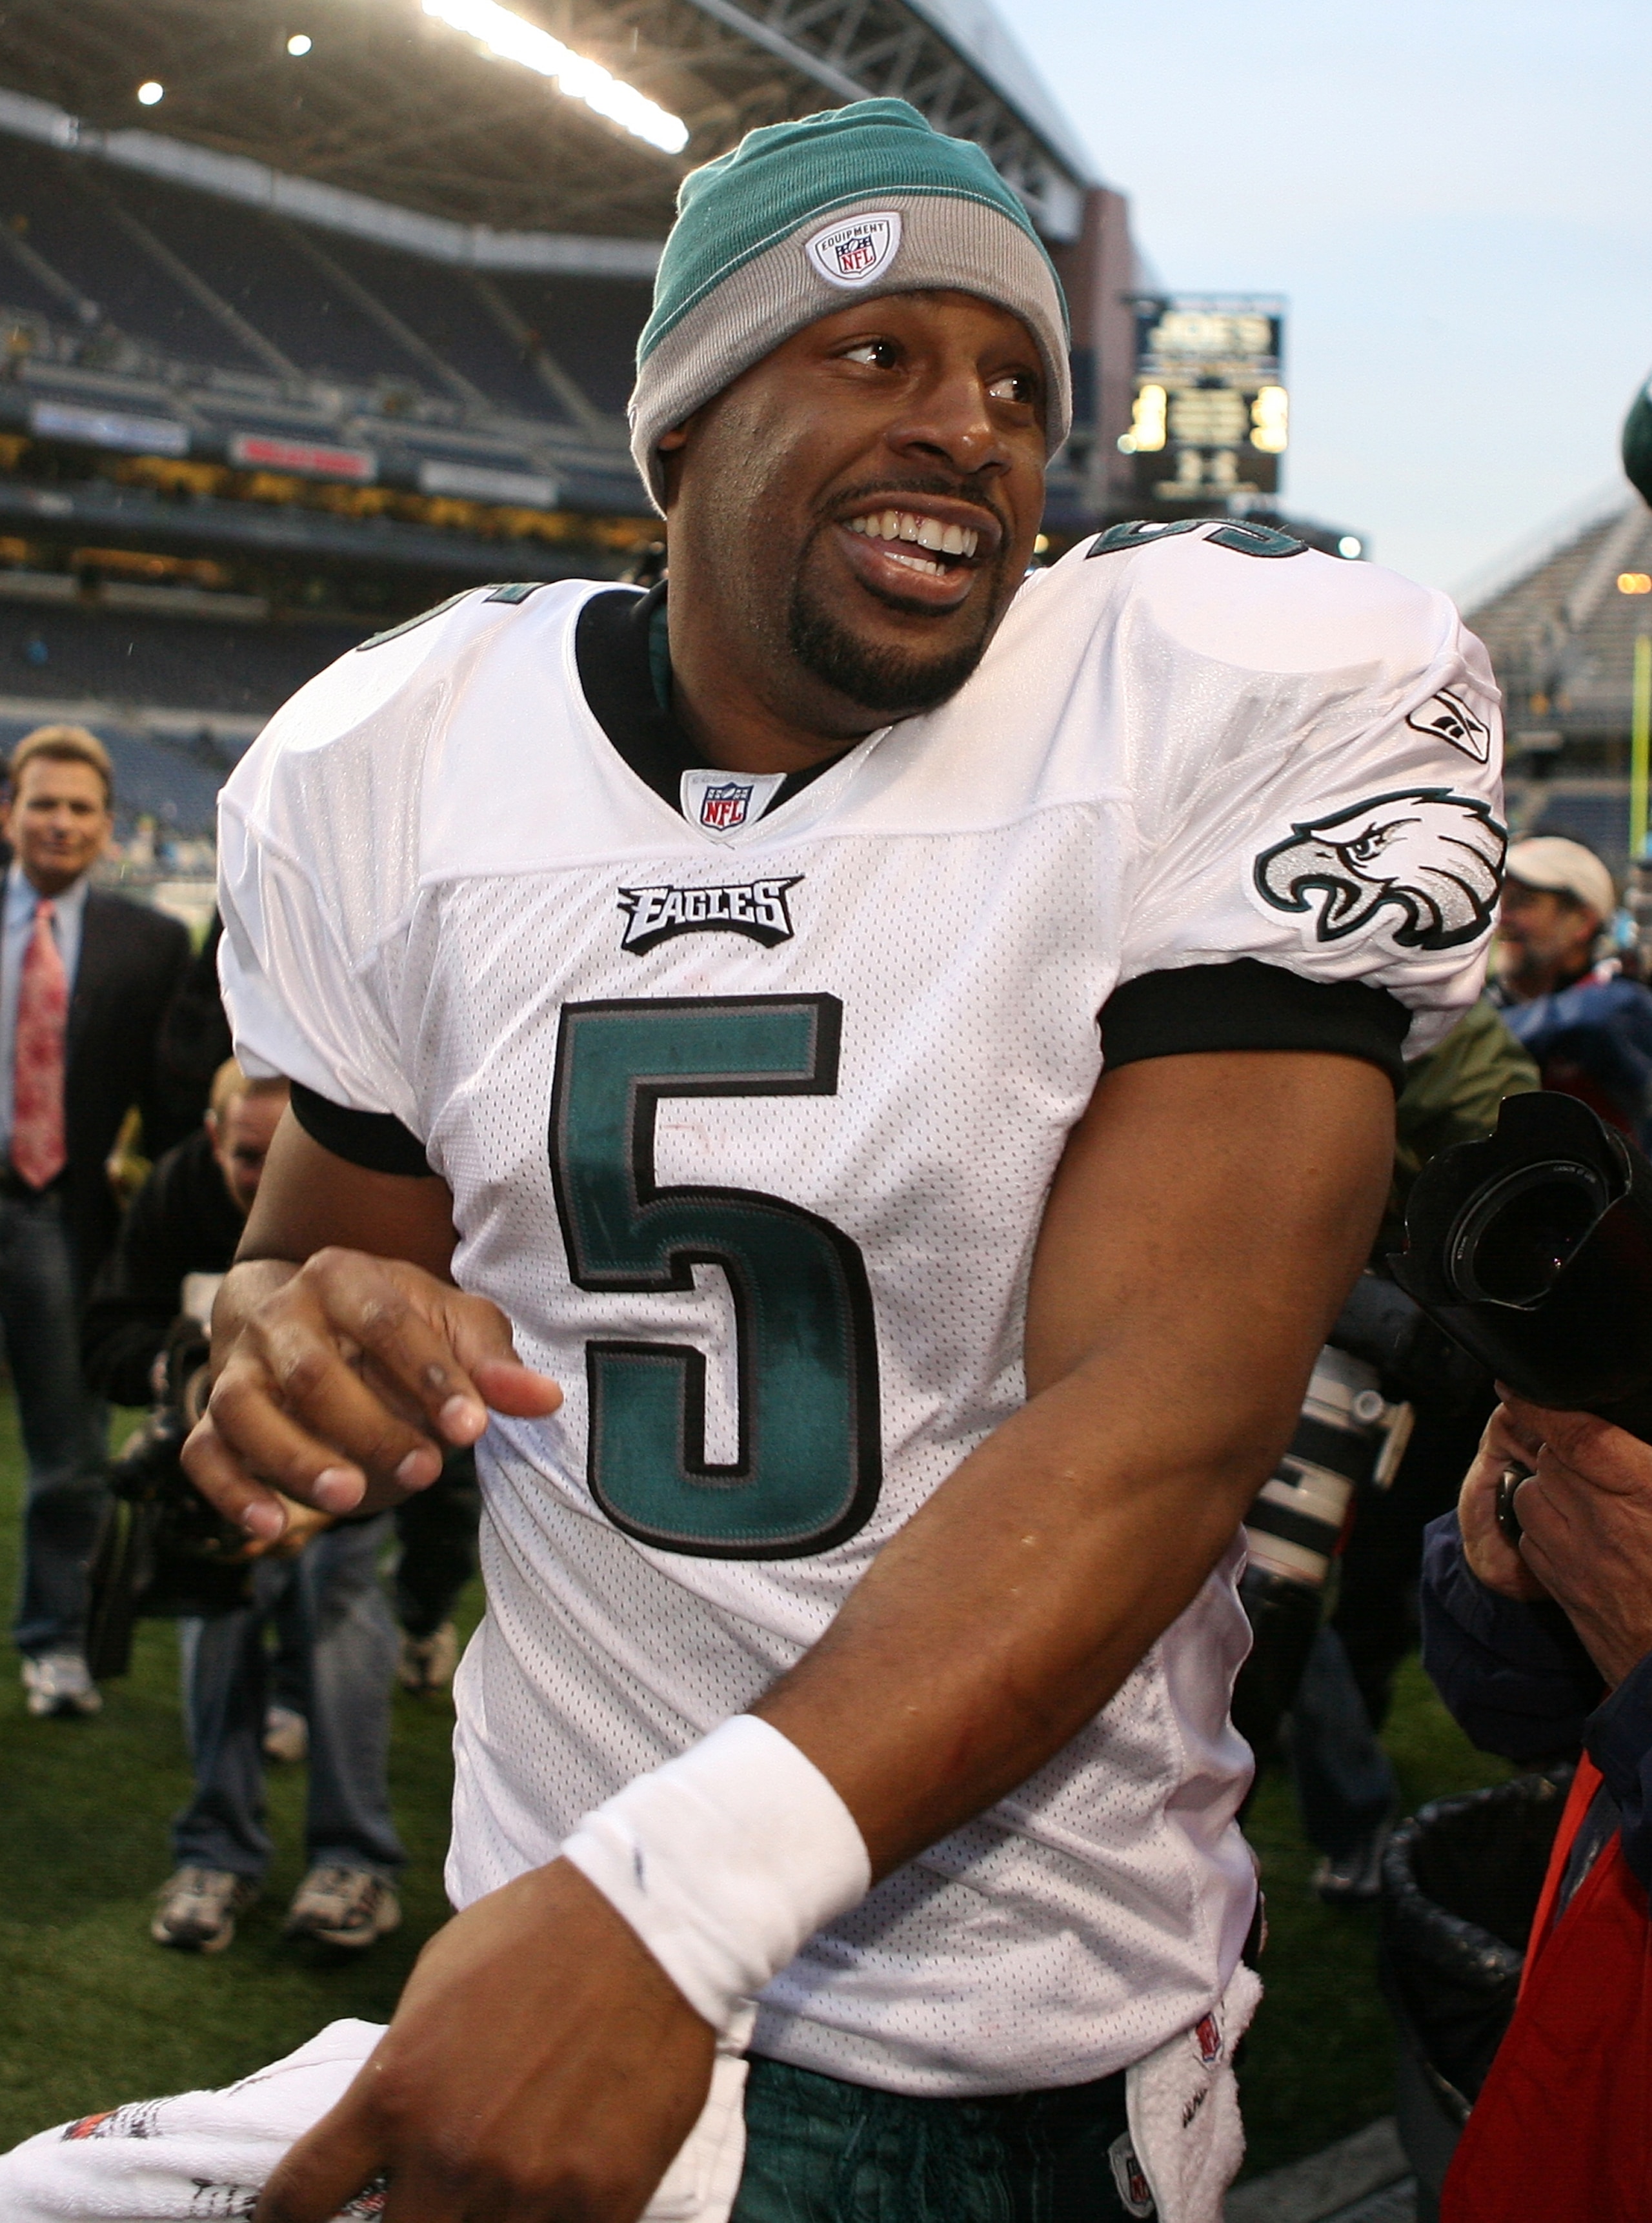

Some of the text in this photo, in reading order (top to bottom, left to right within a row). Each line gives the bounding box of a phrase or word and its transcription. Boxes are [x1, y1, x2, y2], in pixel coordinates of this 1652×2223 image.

[822, 223, 884, 251] EQUIPMENT
[841, 249, 873, 270] NFL
[704, 800, 743, 826] NFL
[620, 876, 803, 953] EAGLES
[548, 991, 883, 1560] 5
